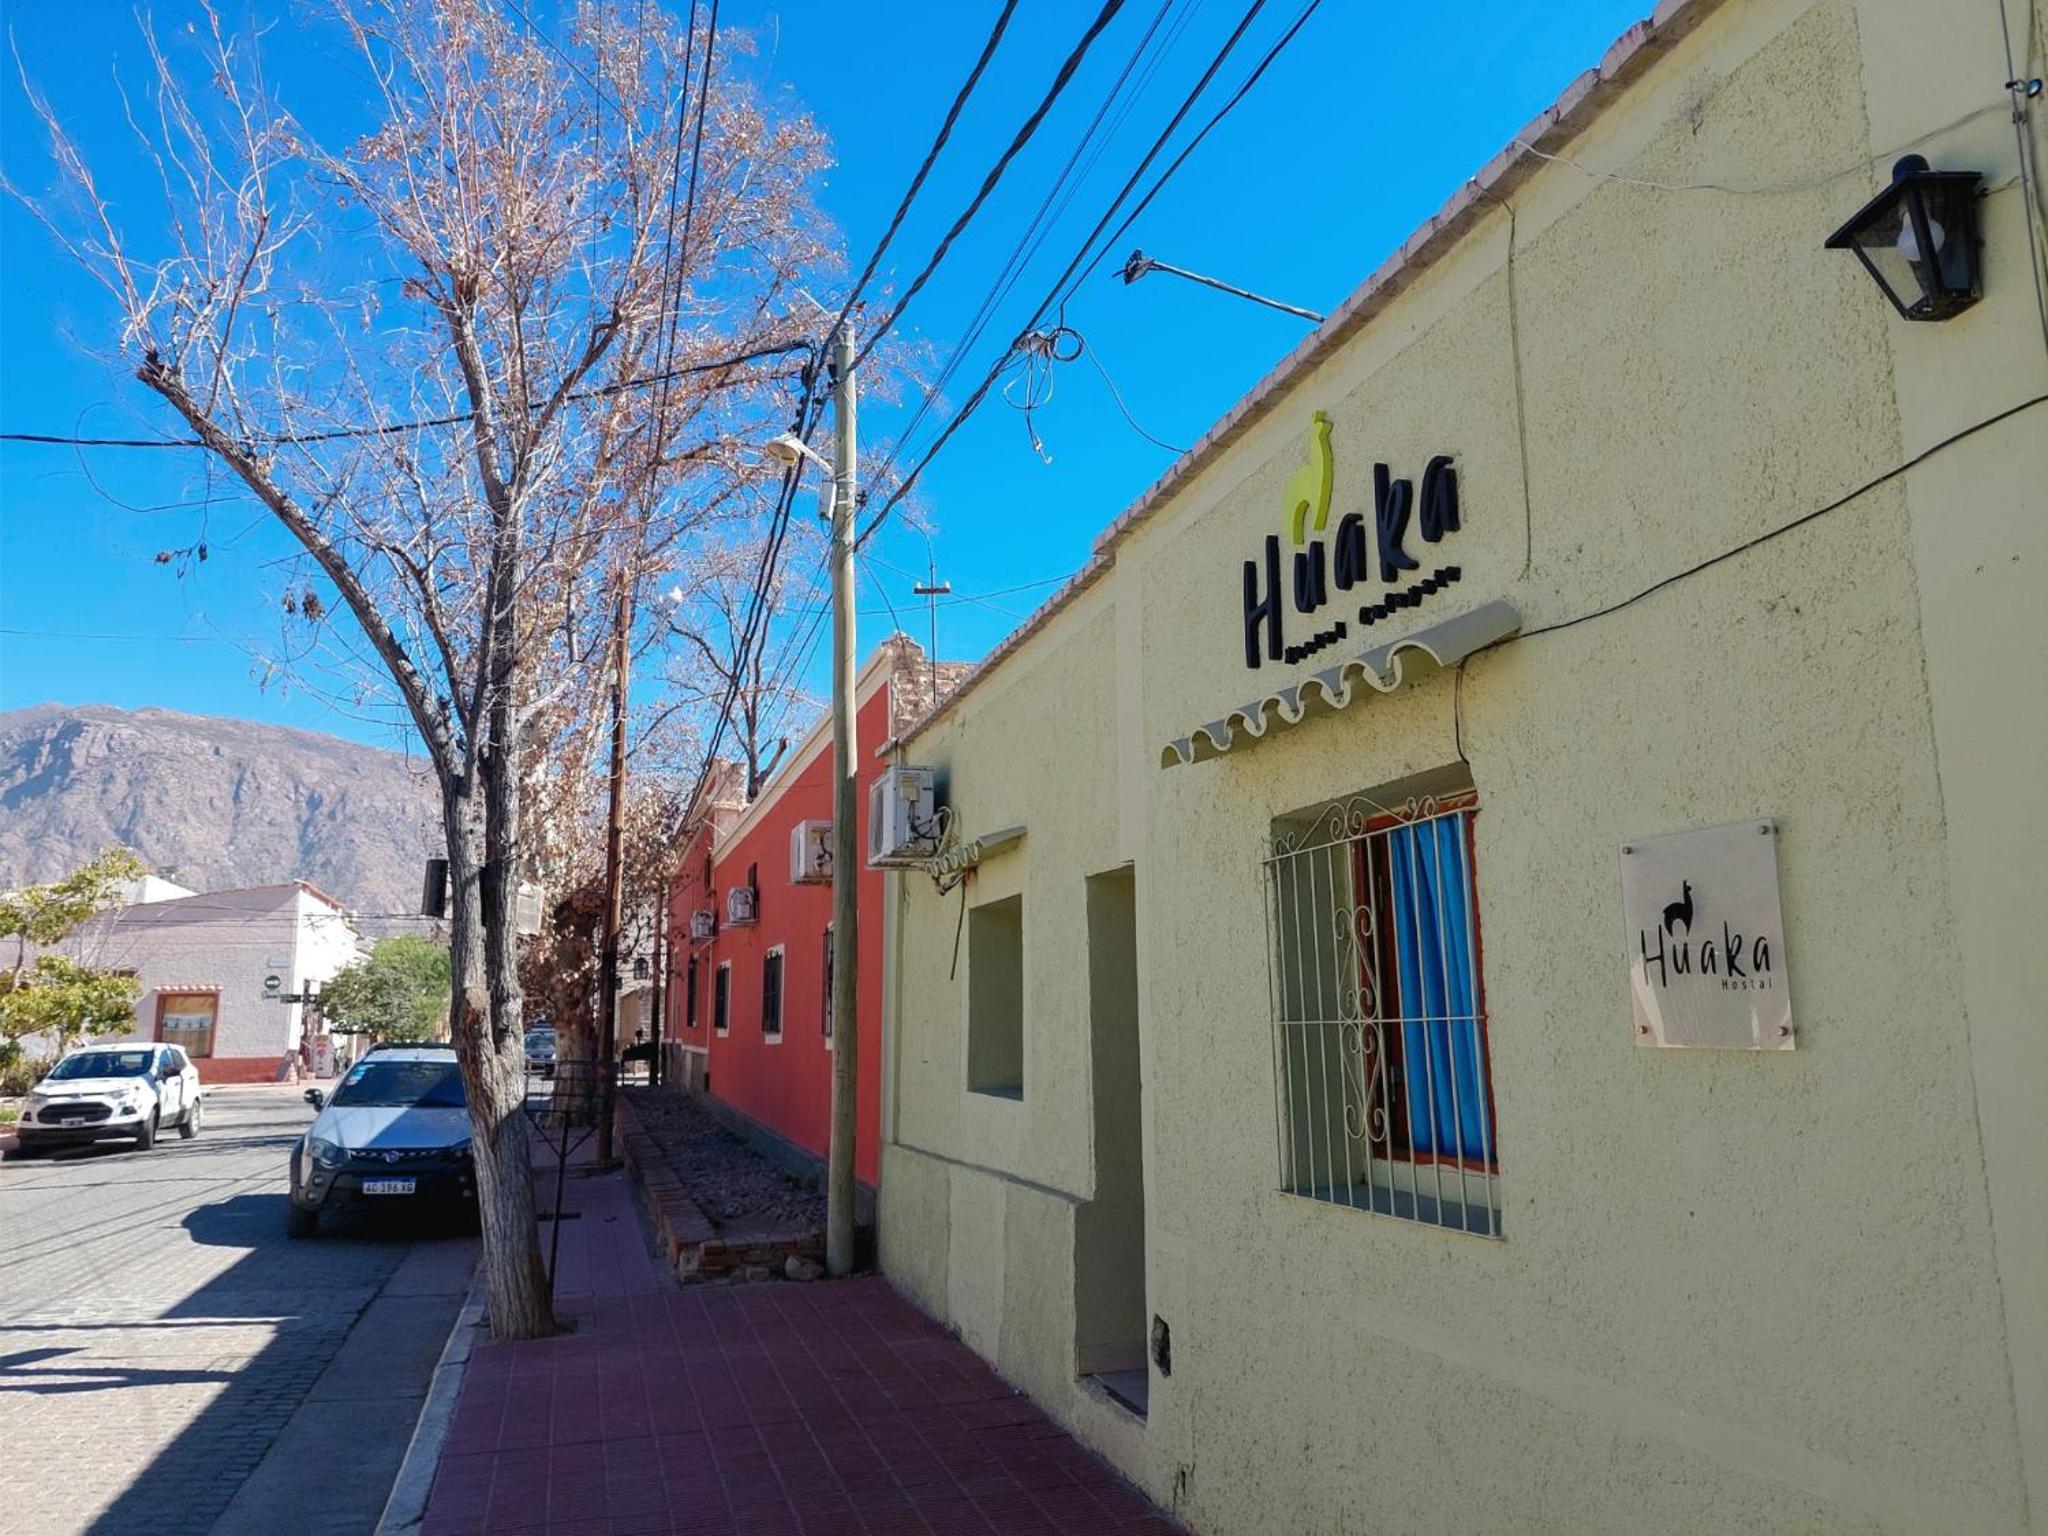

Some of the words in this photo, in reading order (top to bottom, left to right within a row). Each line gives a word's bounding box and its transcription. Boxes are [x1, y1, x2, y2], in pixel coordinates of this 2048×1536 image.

[1244, 455, 1461, 669] Huaka
[1641, 921, 1770, 988] Huaka
[1722, 977, 1773, 990] Hostal
